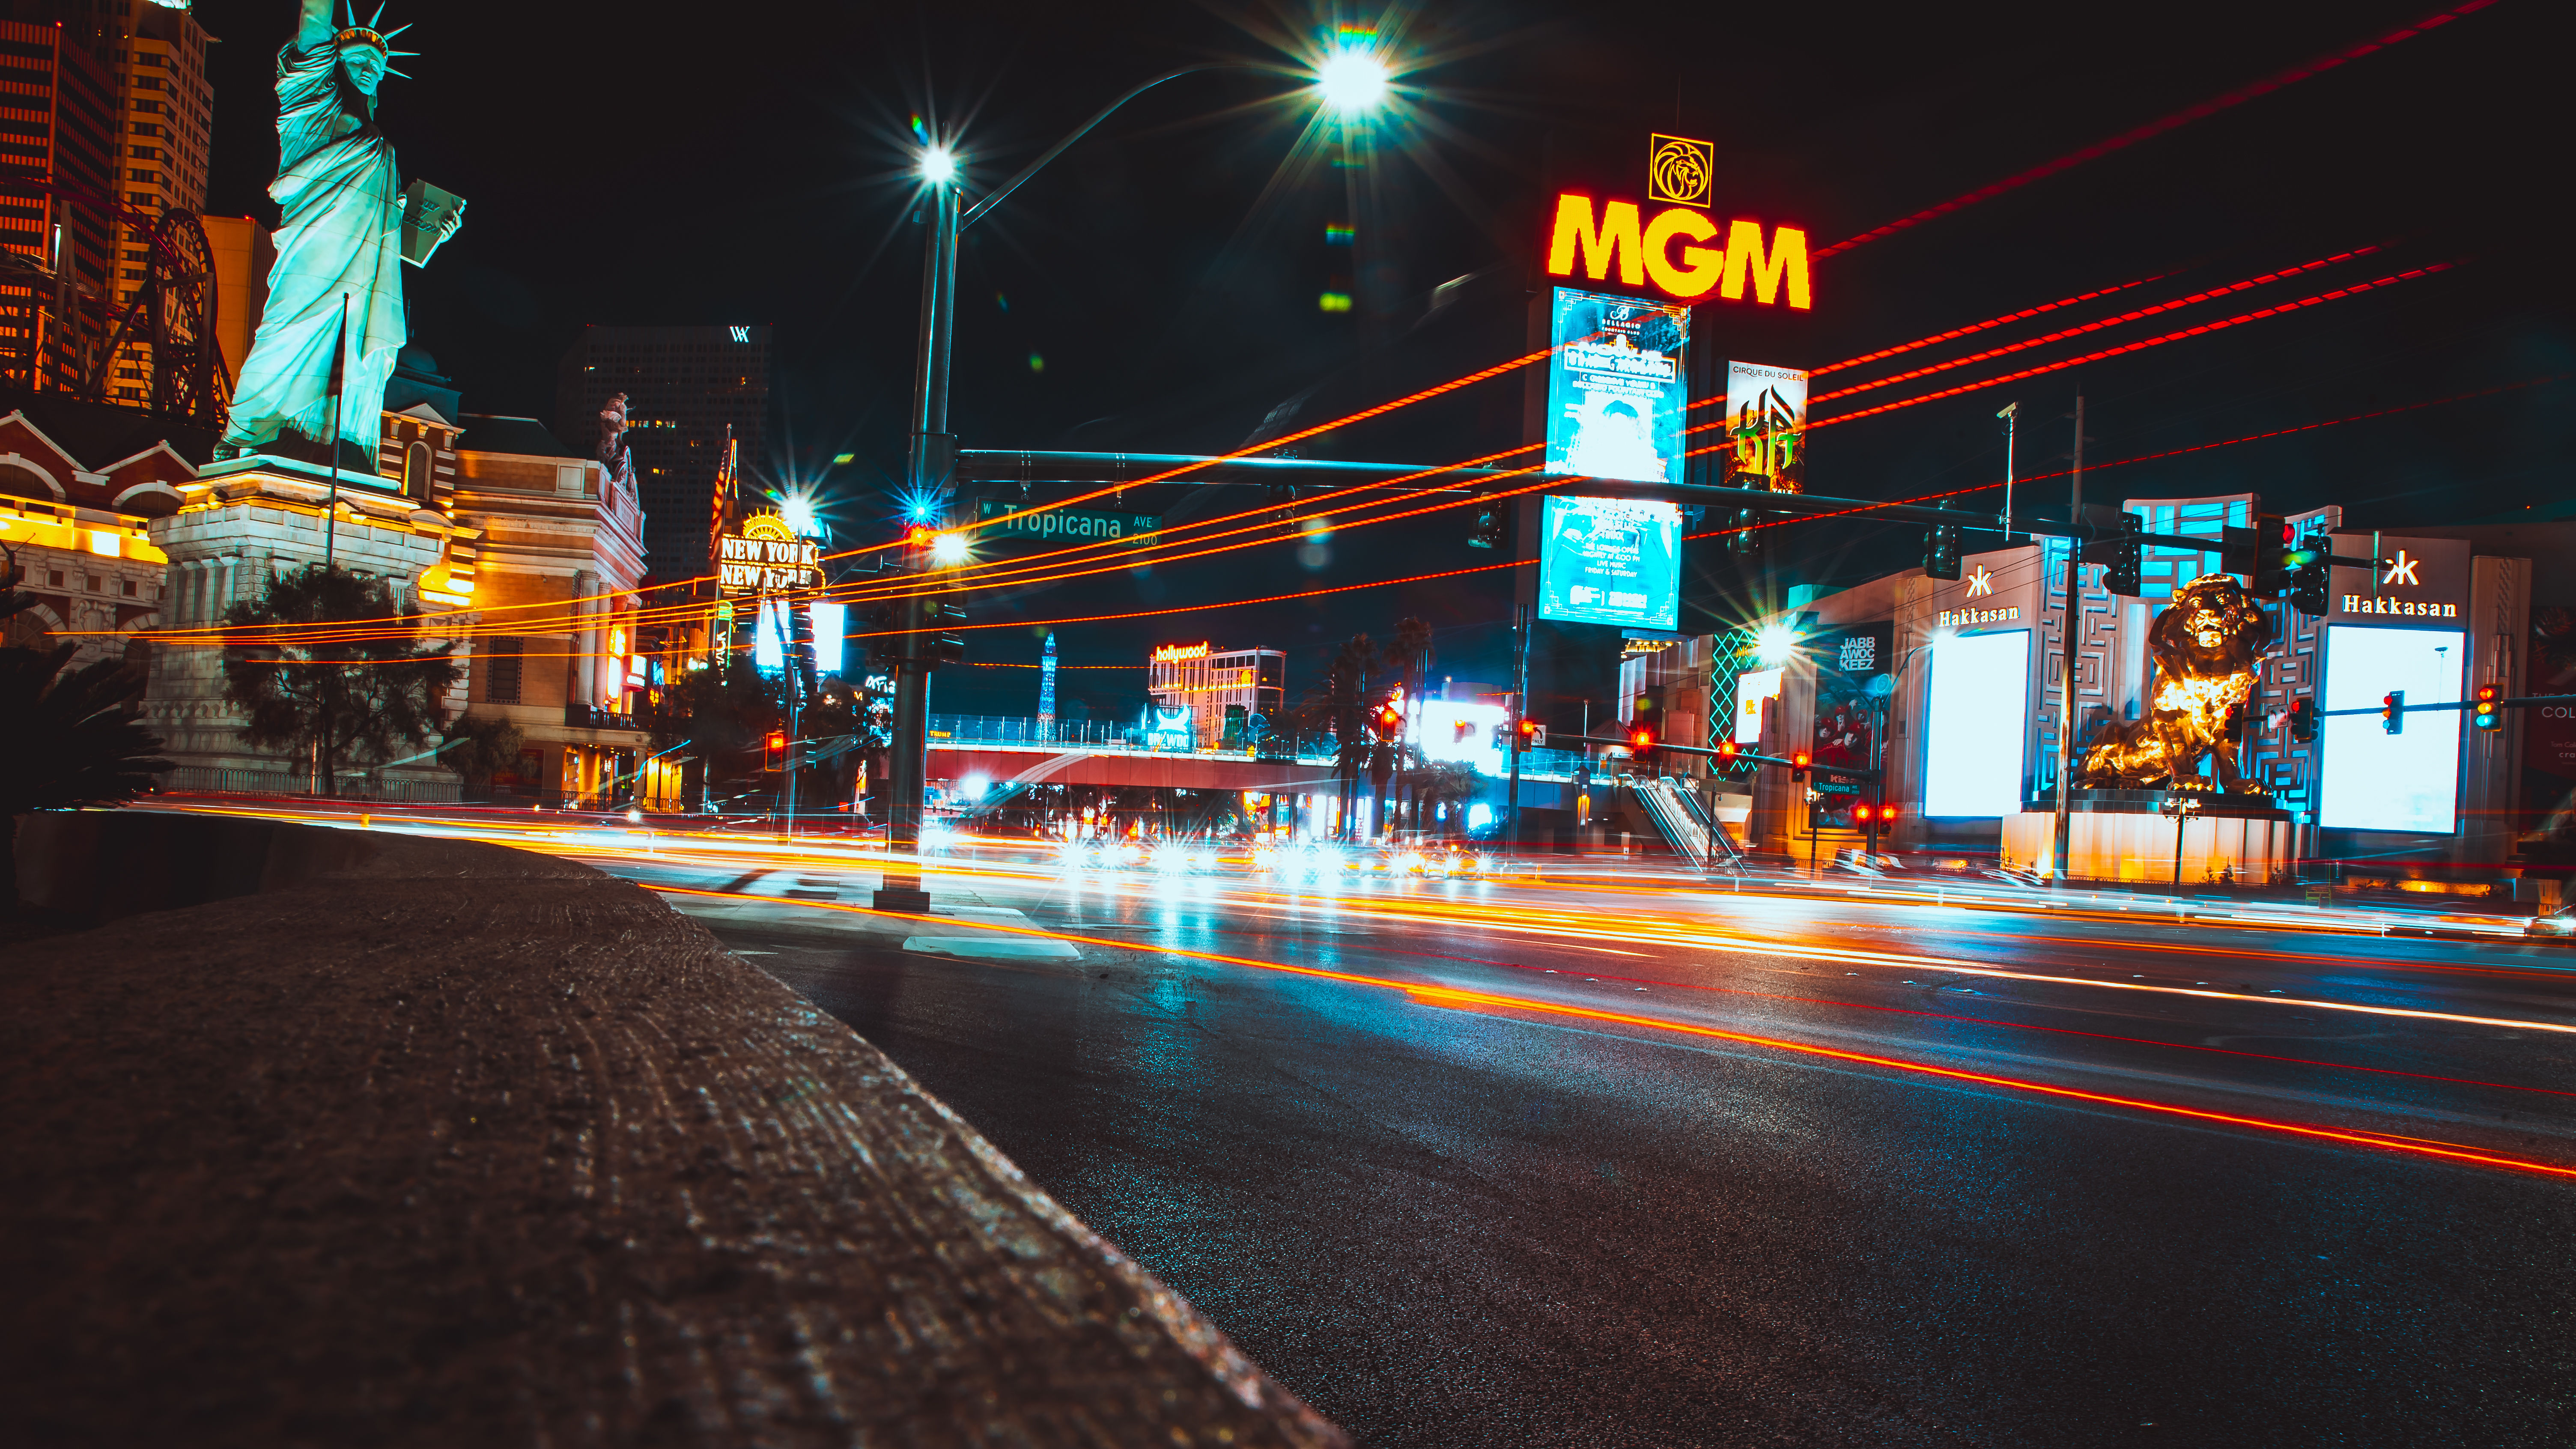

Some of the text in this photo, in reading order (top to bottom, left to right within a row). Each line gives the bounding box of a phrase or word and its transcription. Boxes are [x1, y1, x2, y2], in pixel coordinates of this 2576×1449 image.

[1549, 194, 1810, 310] MGM
[1602, 318, 1641, 329] BELLAGIO
[1733, 366, 1762, 377] CIRQUE
[1777, 373, 1804, 382] SOLEIL
[983, 503, 1121, 538] W Tropicana
[1133, 516, 1153, 528] AVE
[1133, 534, 1157, 546] 2100
[721, 538, 814, 565] NEW YORK
[720, 564, 762, 586] NEW
[1585, 566, 1604, 574] FRIDAY
[1611, 569, 1637, 578] SATURDAY
[2343, 594, 2457, 618] Hakkasan
[1938, 605, 2020, 628] Hakkasan
[1840, 637, 1875, 650] JABB
[1156, 641, 1208, 664] hollywood
[1840, 648, 1875, 660] AWOC
[1839, 658, 1874, 671] KEEZ
[865, 675, 896, 694] Aria
[1819, 782, 1849, 793] Tropicana
